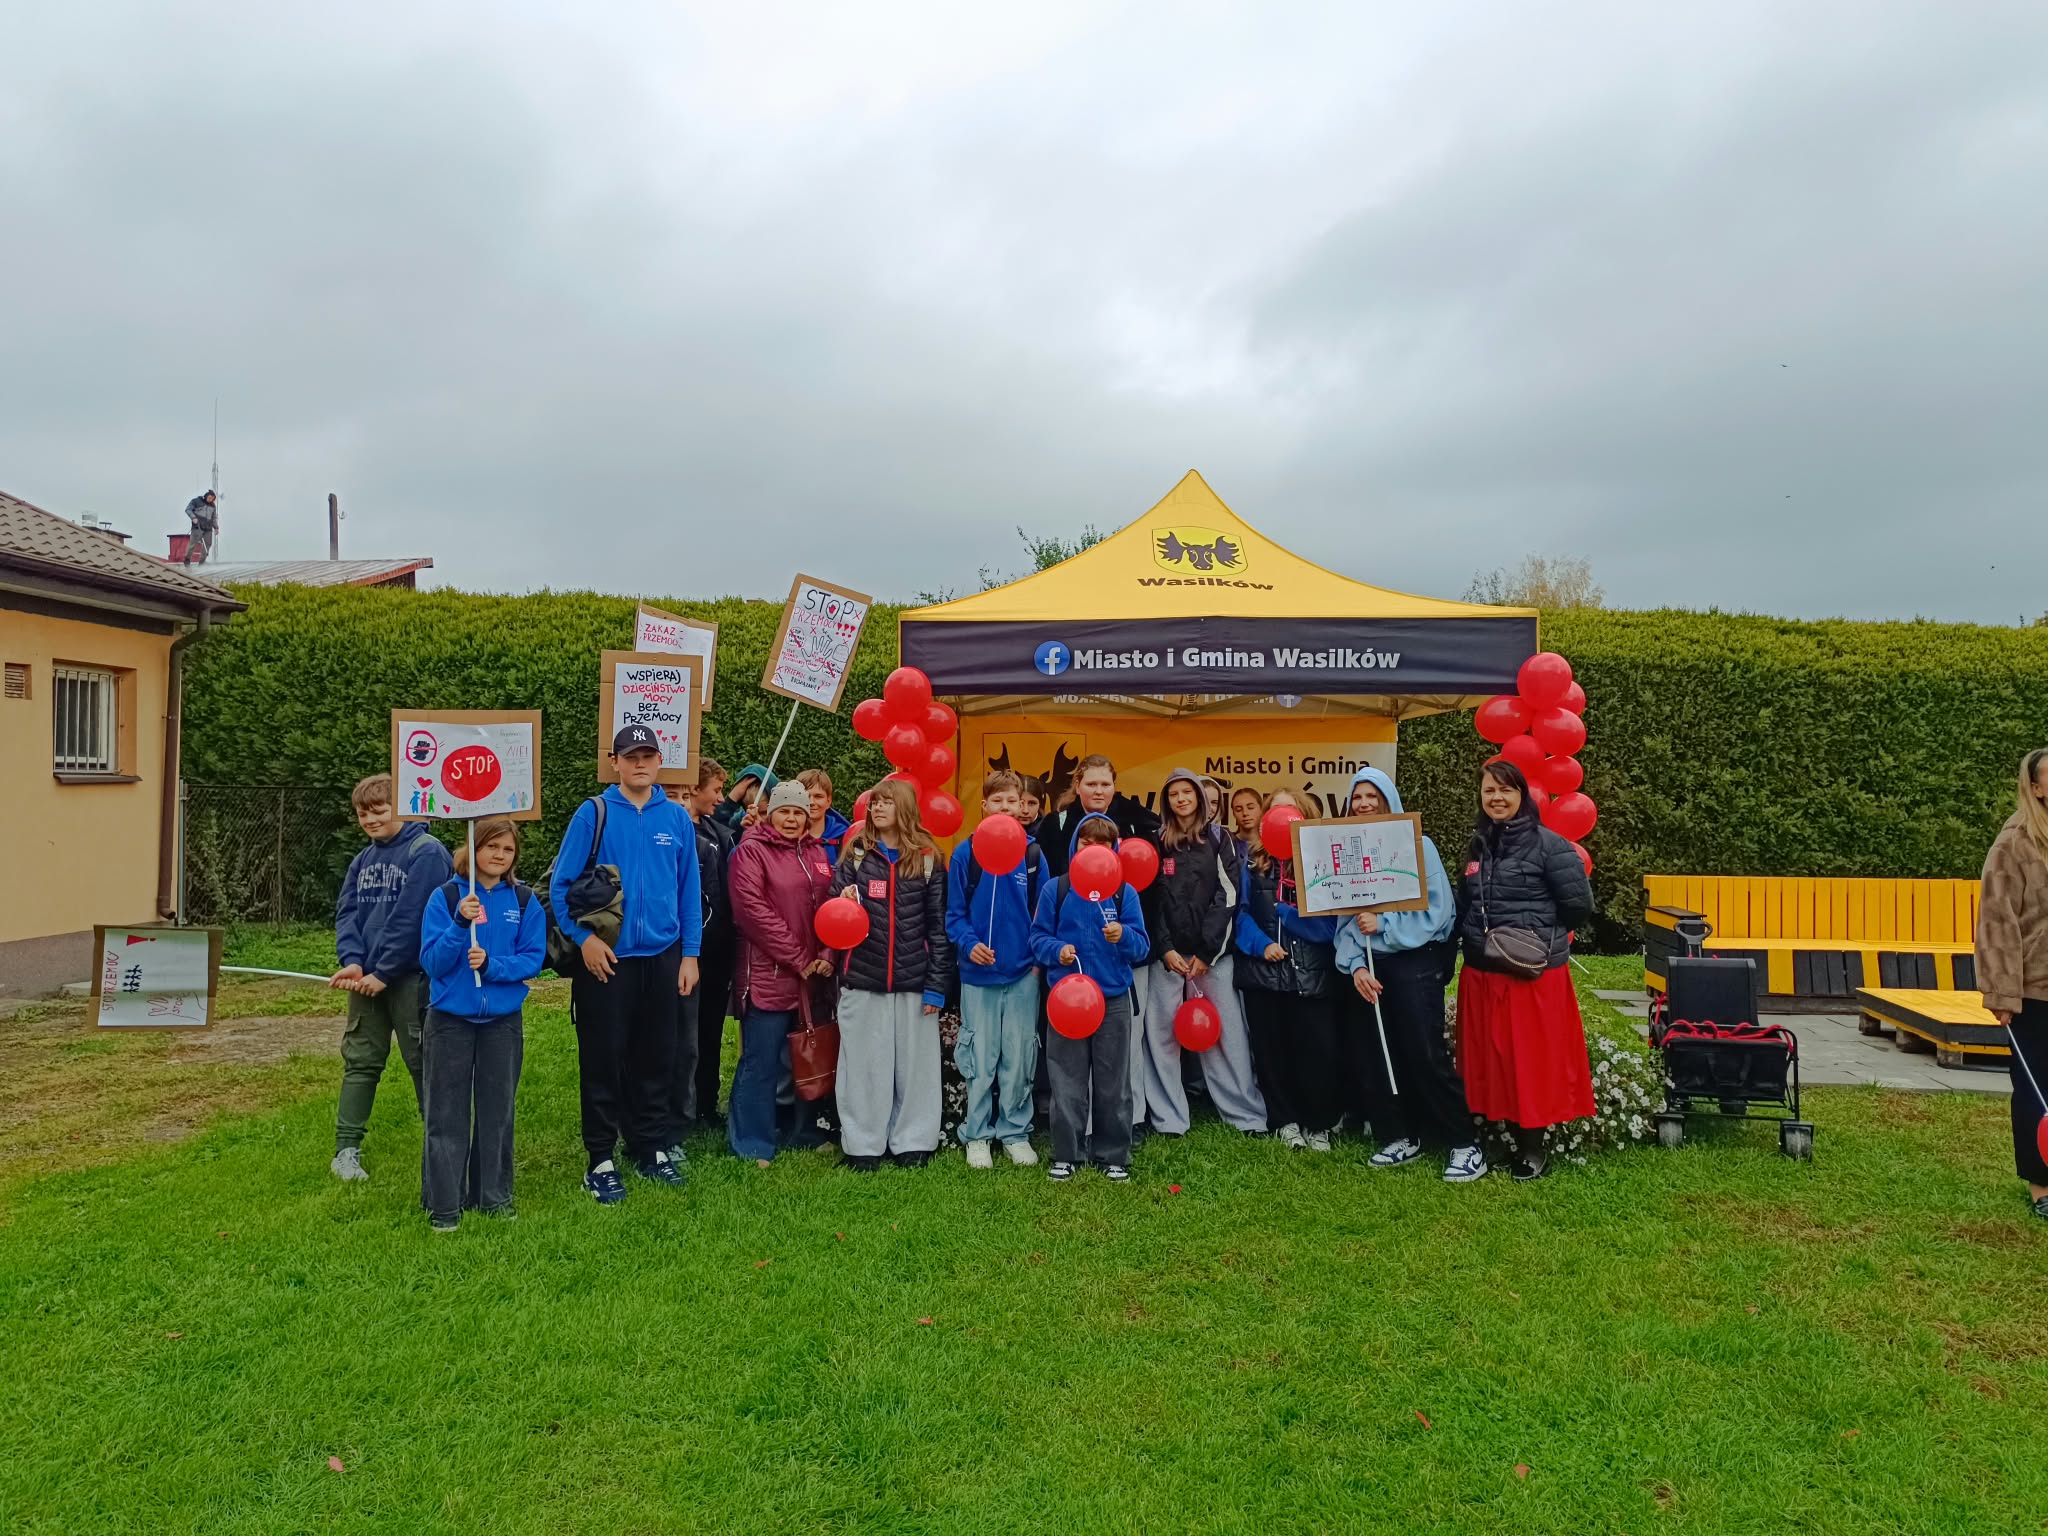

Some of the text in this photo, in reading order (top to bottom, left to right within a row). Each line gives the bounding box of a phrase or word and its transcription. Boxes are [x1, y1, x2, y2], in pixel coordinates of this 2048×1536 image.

[1137, 577, 1273, 591] Wasilków
[803, 589, 855, 623] STOP
[644, 623, 677, 636] ZAKAZ
[1074, 649, 1159, 670] Miasto
[1167, 648, 1175, 667] i
[1183, 648, 1265, 668] Gmina
[1273, 648, 1400, 668] Wasilków
[451, 755, 495, 780] STOP
[1205, 756, 1282, 775] Miasto
[1288, 756, 1295, 774] i
